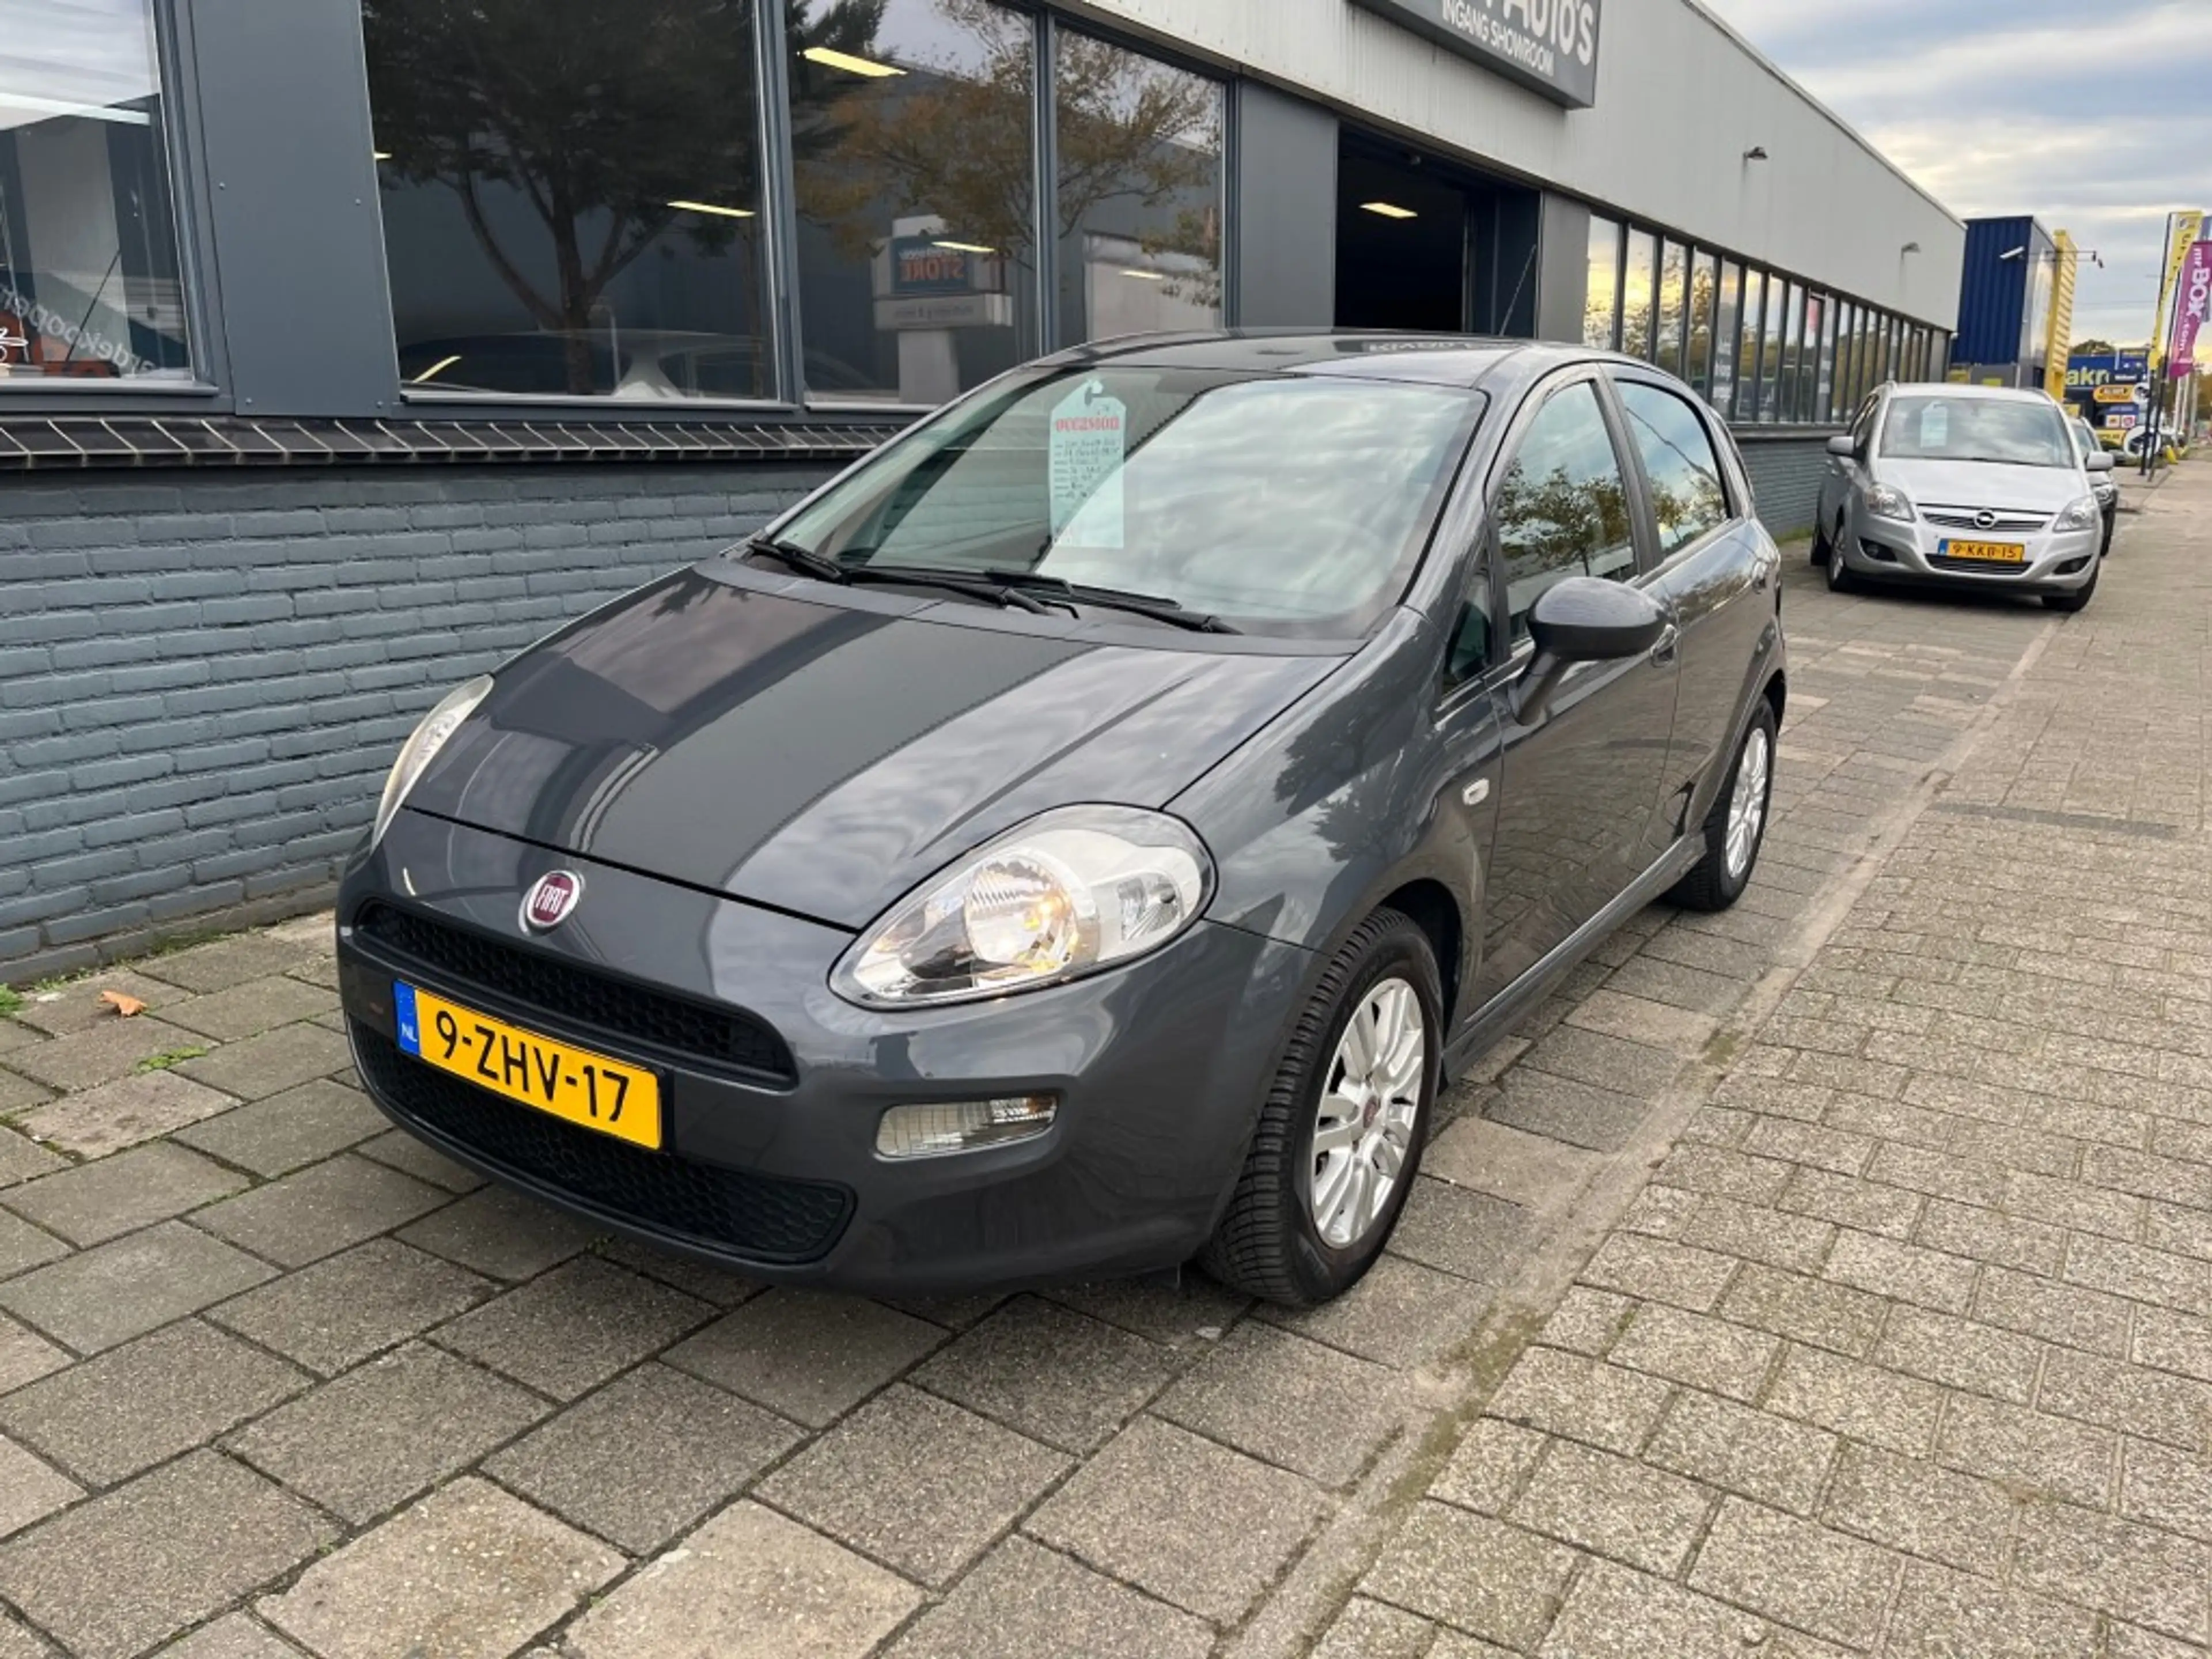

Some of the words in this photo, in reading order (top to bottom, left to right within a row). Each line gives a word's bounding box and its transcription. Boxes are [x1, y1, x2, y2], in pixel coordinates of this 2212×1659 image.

[1442, 0, 1489, 42] INGANG
[1490, 20, 1554, 77] SHOWROOM
[535, 884, 570, 915] FIAT
[401, 1022, 418, 1043] NL
[435, 1010, 630, 1122] 9-ZHV-17
